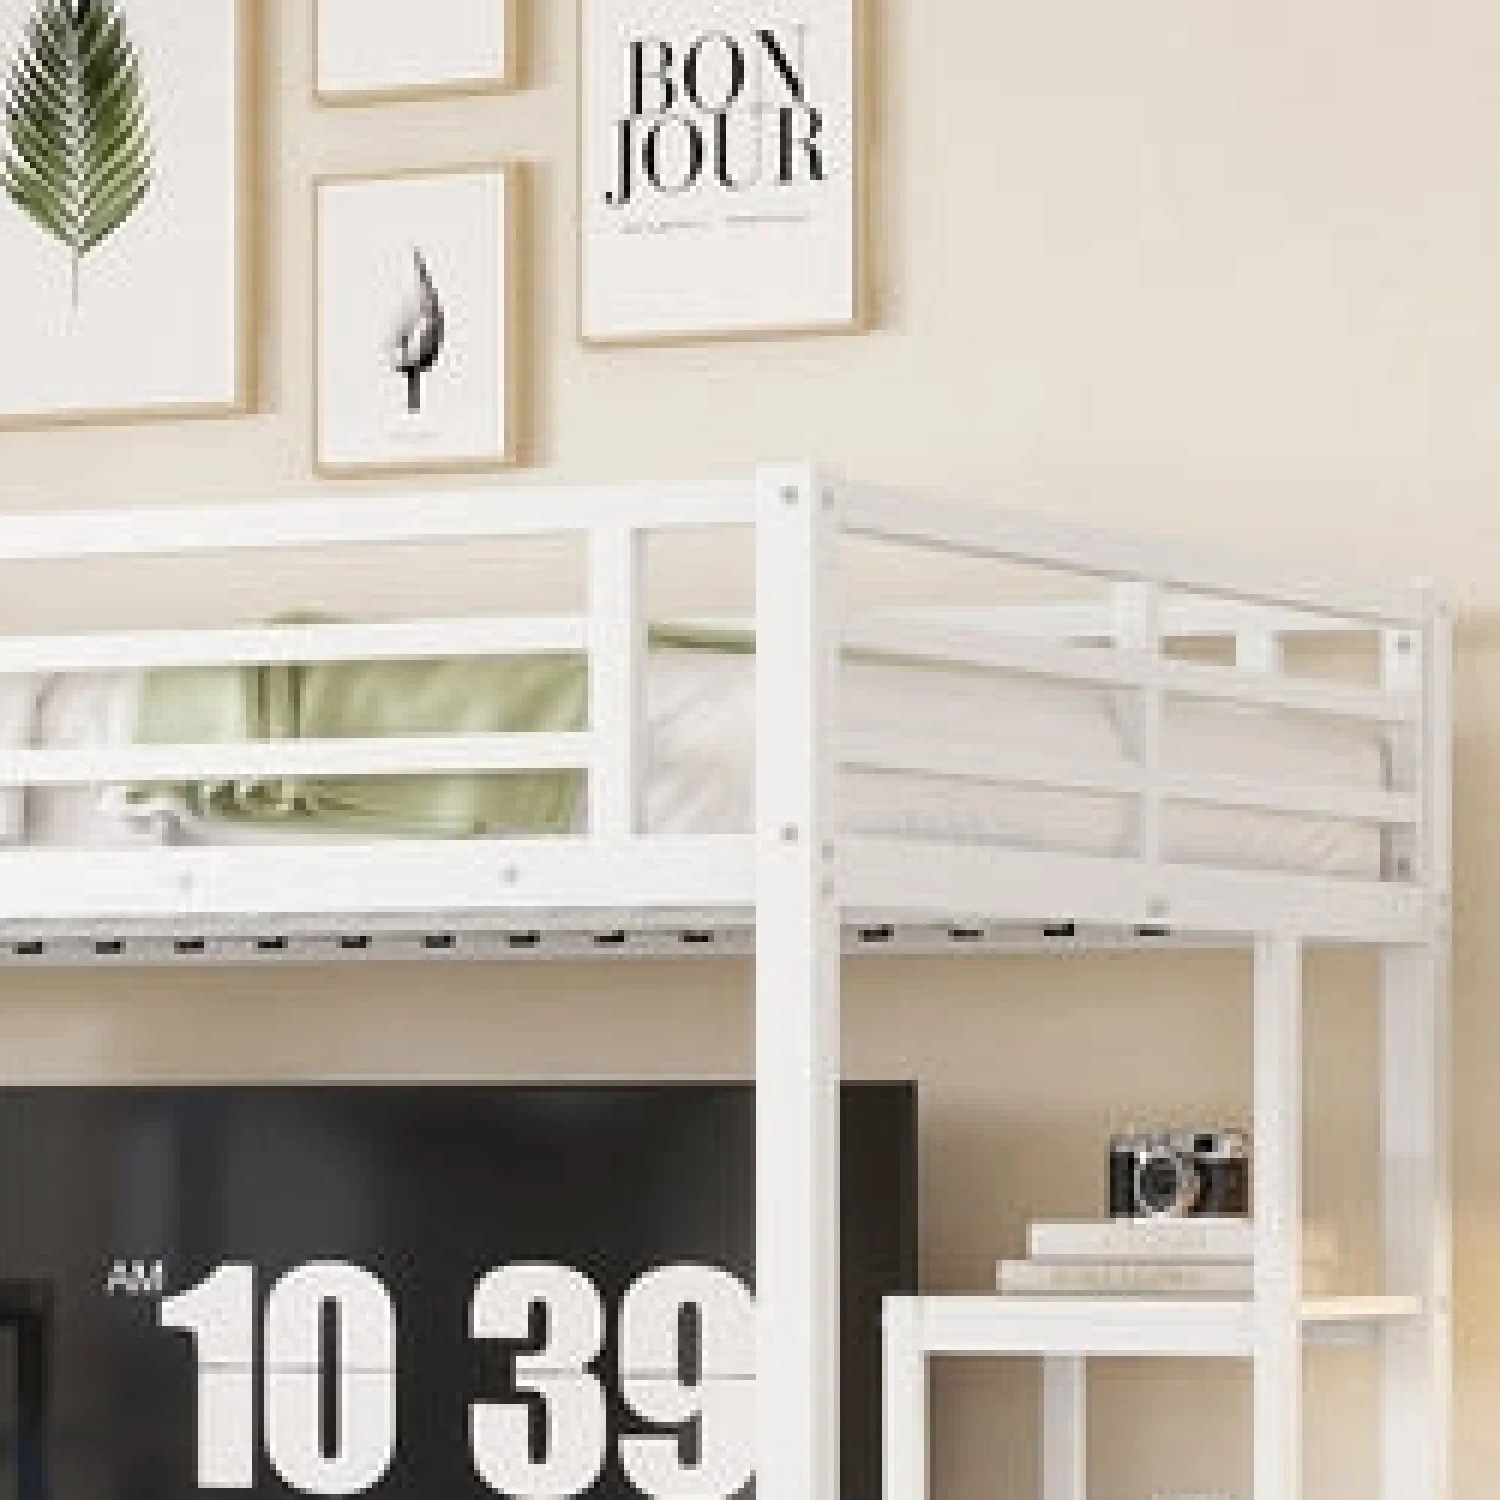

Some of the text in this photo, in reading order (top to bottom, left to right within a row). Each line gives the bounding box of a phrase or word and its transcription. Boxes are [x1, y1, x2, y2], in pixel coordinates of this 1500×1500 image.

[627, 26, 806, 116] BON
[604, 105, 829, 207] JOUR
[105, 1258, 163, 1293] AM
[159, 1258, 398, 1497] 10
